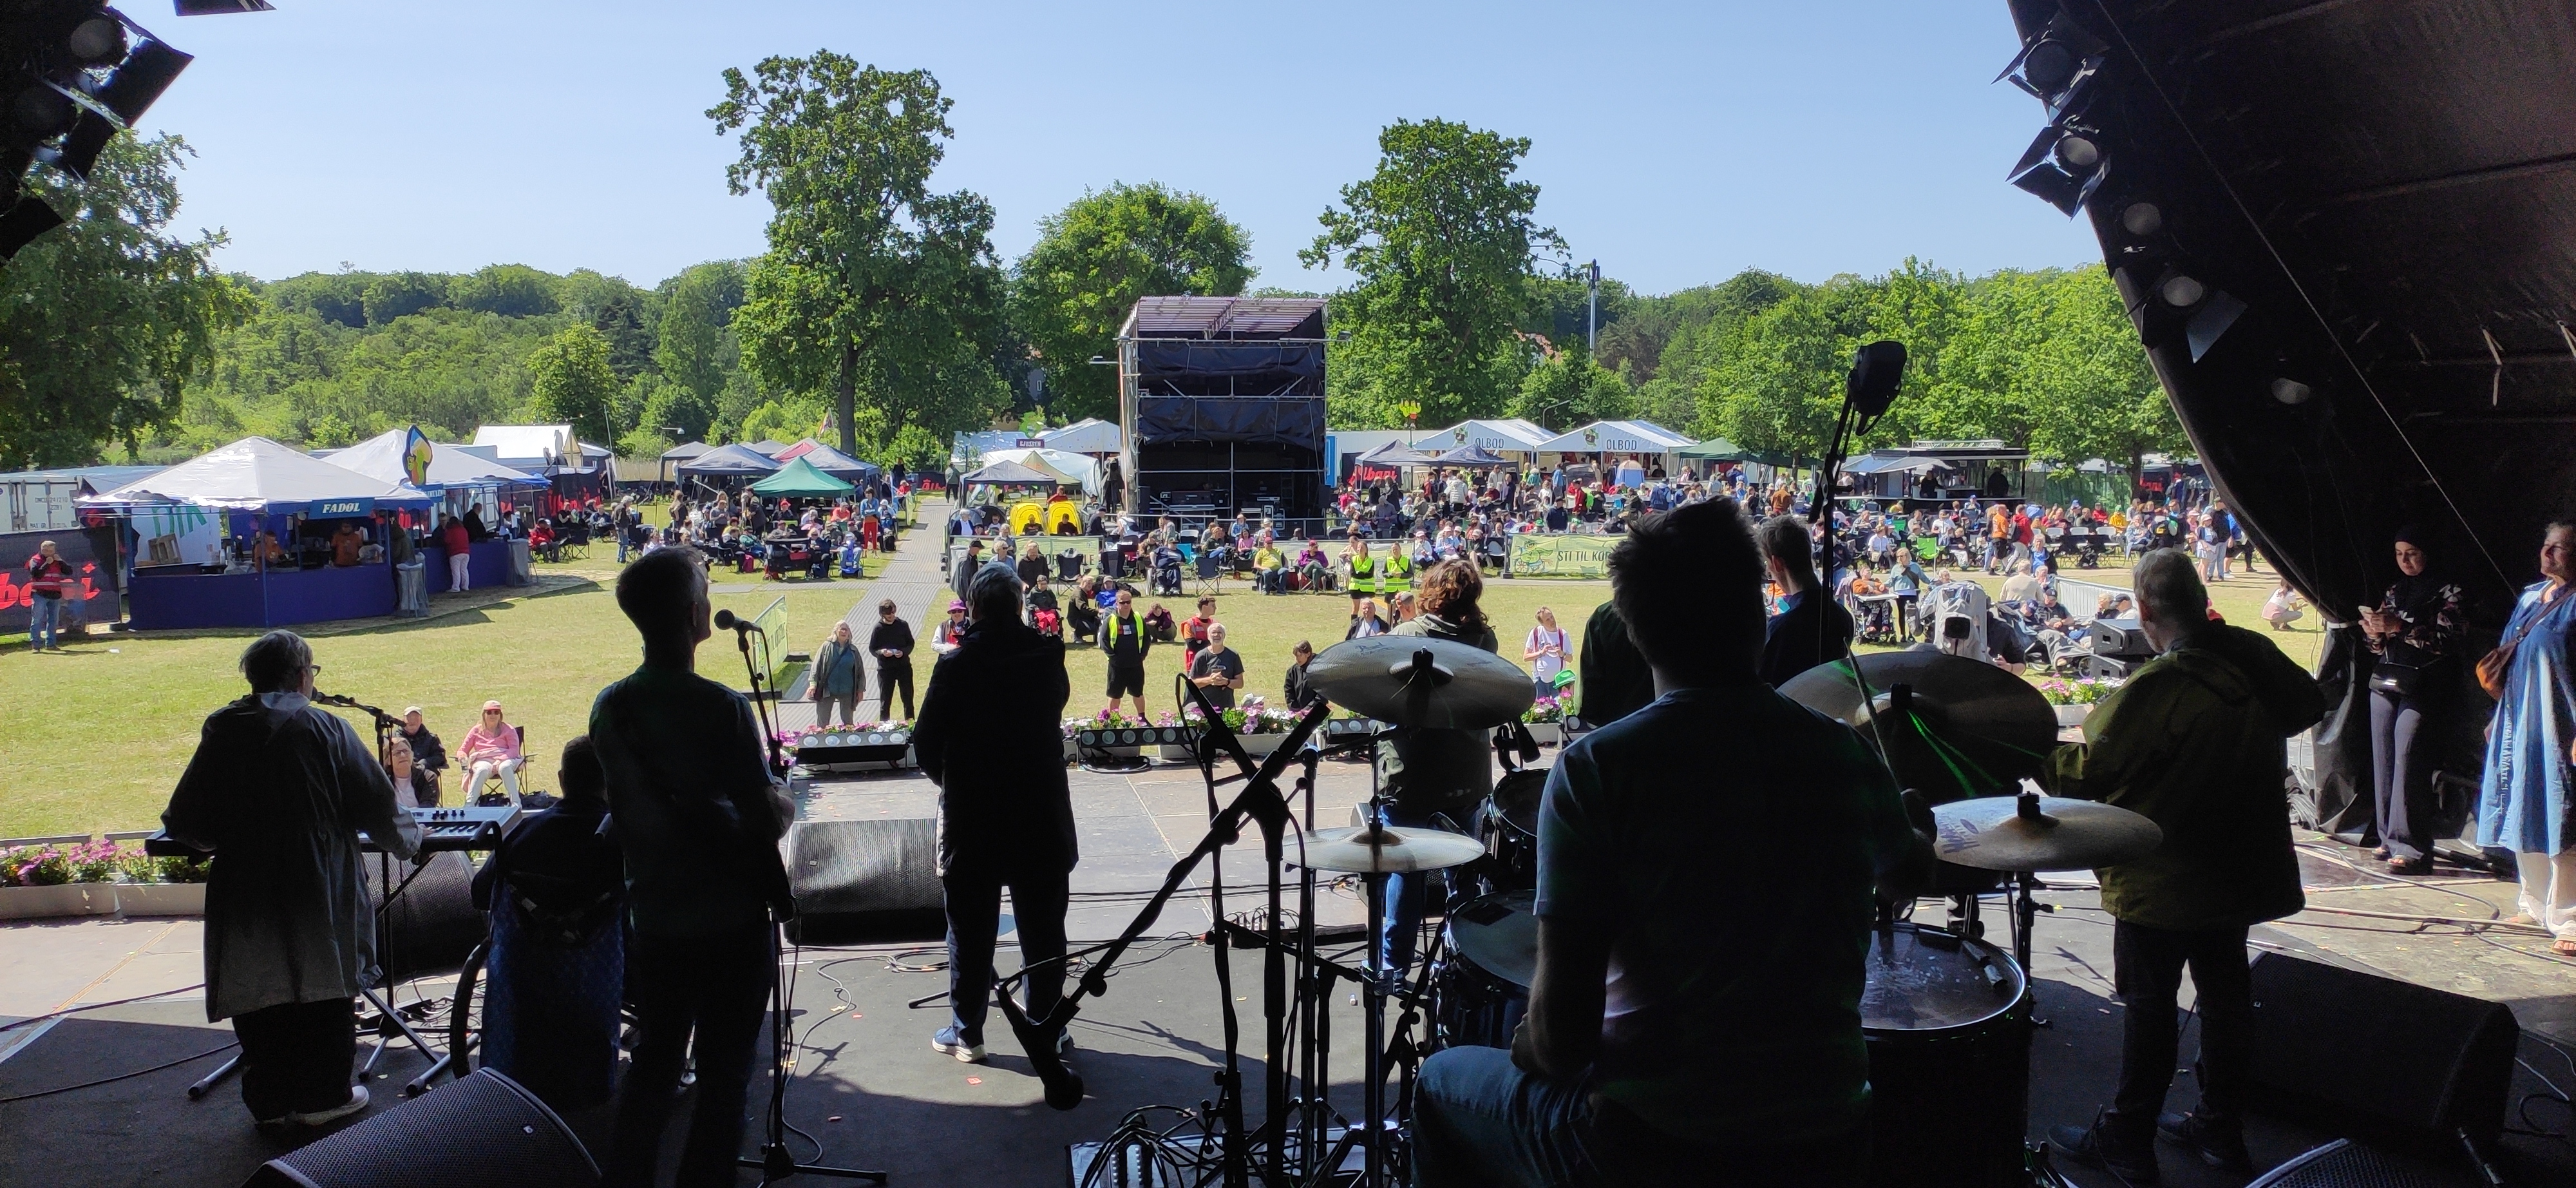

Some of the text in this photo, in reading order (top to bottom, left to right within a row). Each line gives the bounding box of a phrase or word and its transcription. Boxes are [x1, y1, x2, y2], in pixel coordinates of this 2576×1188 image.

[322, 502, 361, 513] FADØL
[1558, 551, 1571, 562] STI
[1577, 551, 1589, 562] TIL
